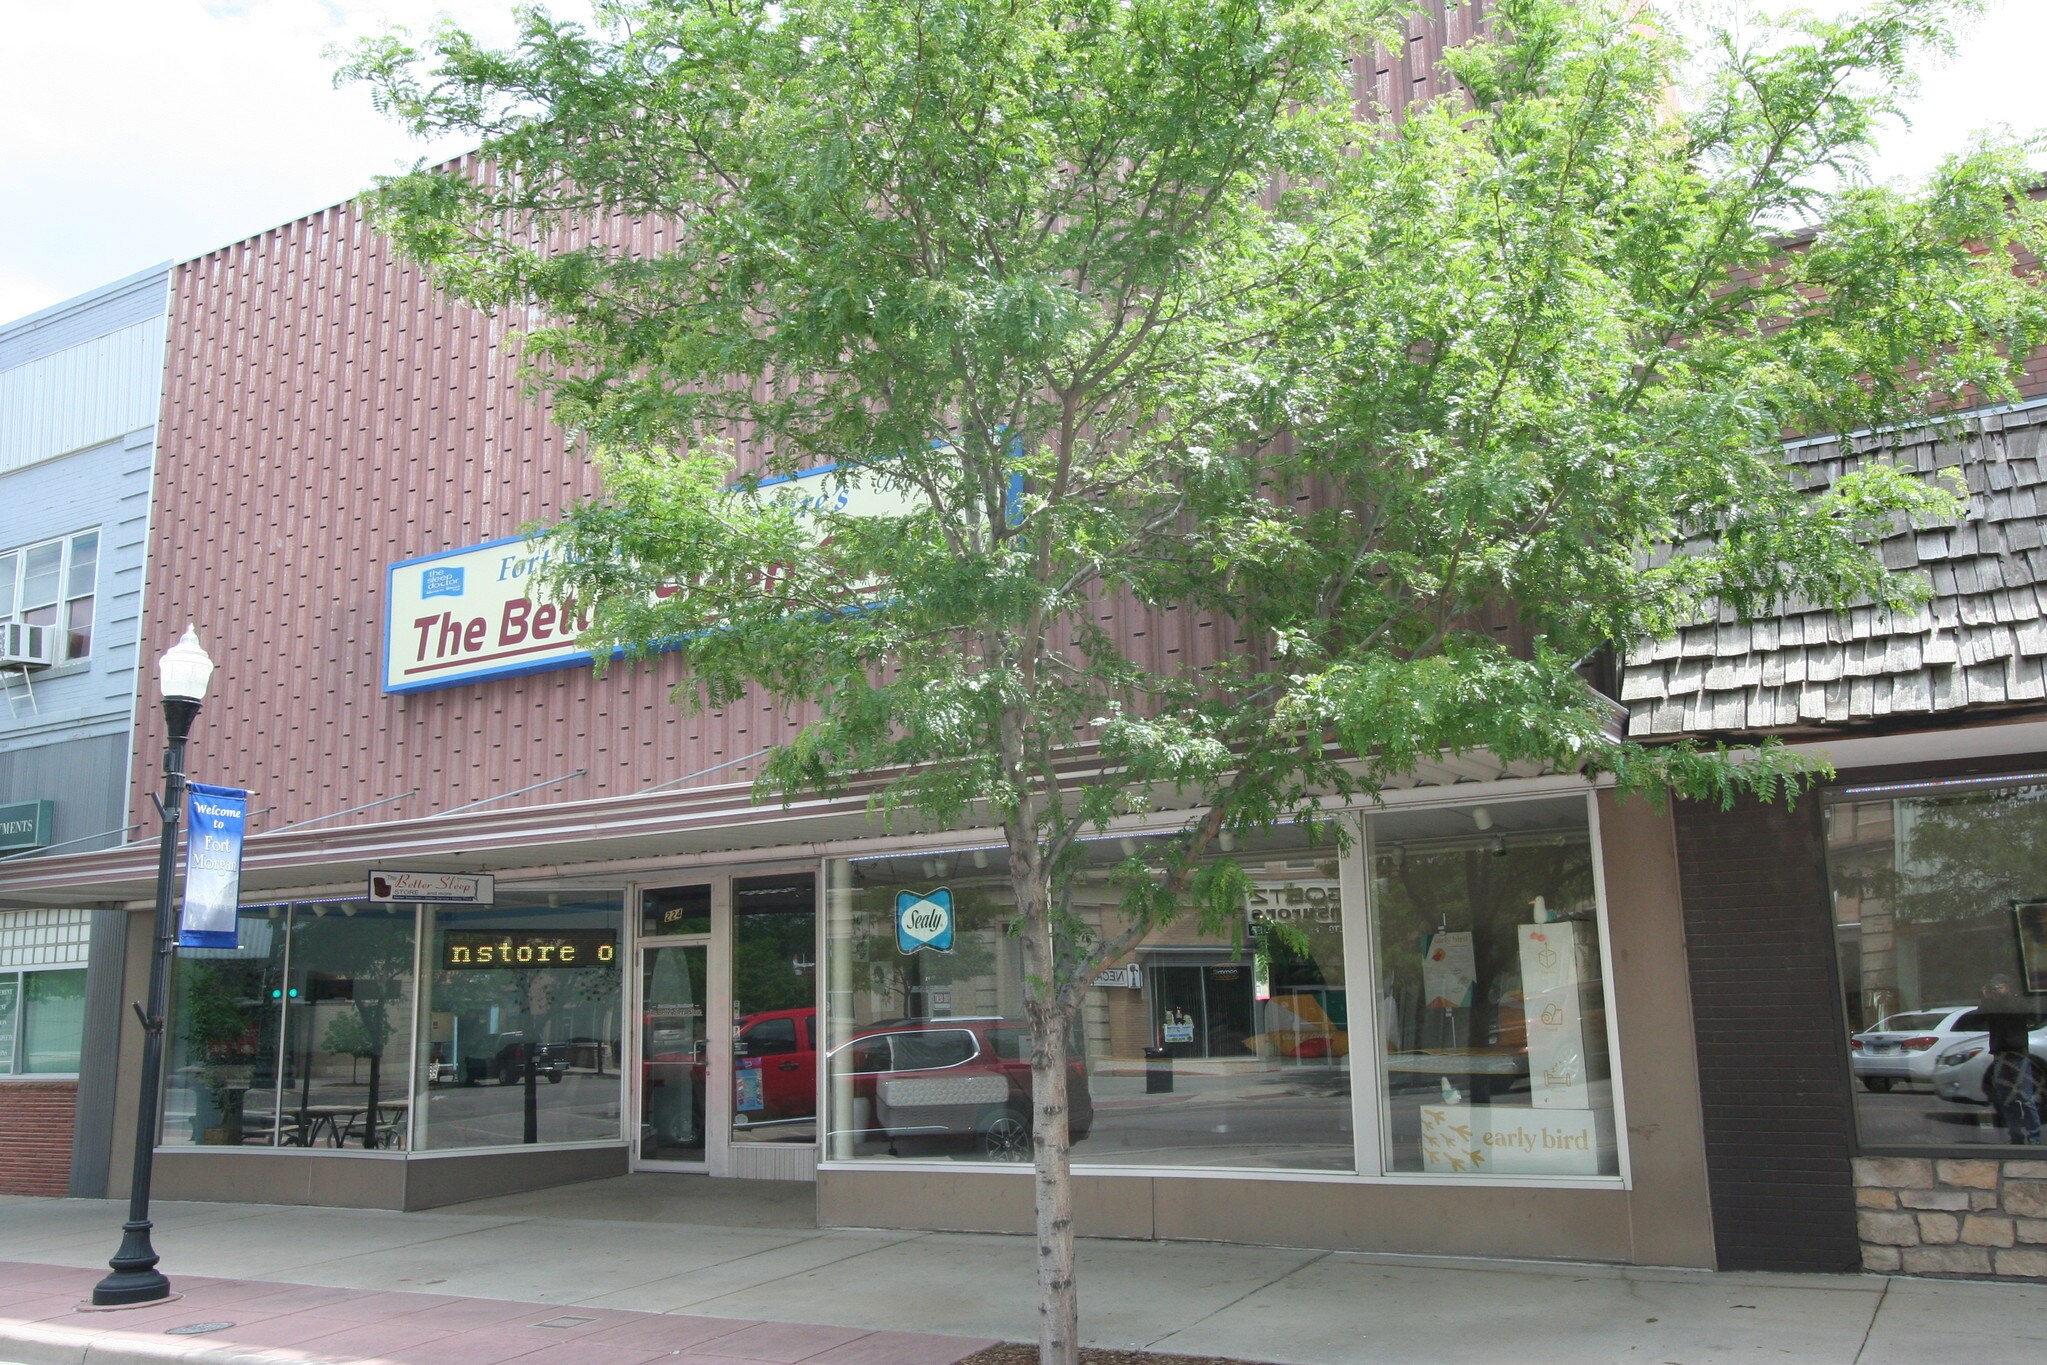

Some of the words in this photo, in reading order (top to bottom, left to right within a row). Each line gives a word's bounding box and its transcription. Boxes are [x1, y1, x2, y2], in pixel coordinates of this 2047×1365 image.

[429, 569, 445, 578] the
[496, 549, 550, 582] Fort
[426, 574, 453, 584] sleep
[427, 578, 459, 590] doctor
[413, 610, 488, 662] The
[498, 590, 593, 647] Bett
[194, 801, 241, 818] Welcome
[213, 819, 225, 829] to
[204, 835, 232, 853] Fort
[191, 853, 237, 876] Morgan
[394, 874, 432, 889] Better
[435, 875, 471, 893] Sleep
[666, 909, 682, 922] 224
[906, 908, 942, 932] Sealy
[451, 943, 575, 963] nstore
[1482, 1126, 1537, 1153] early
[1541, 1127, 1589, 1151] bird
